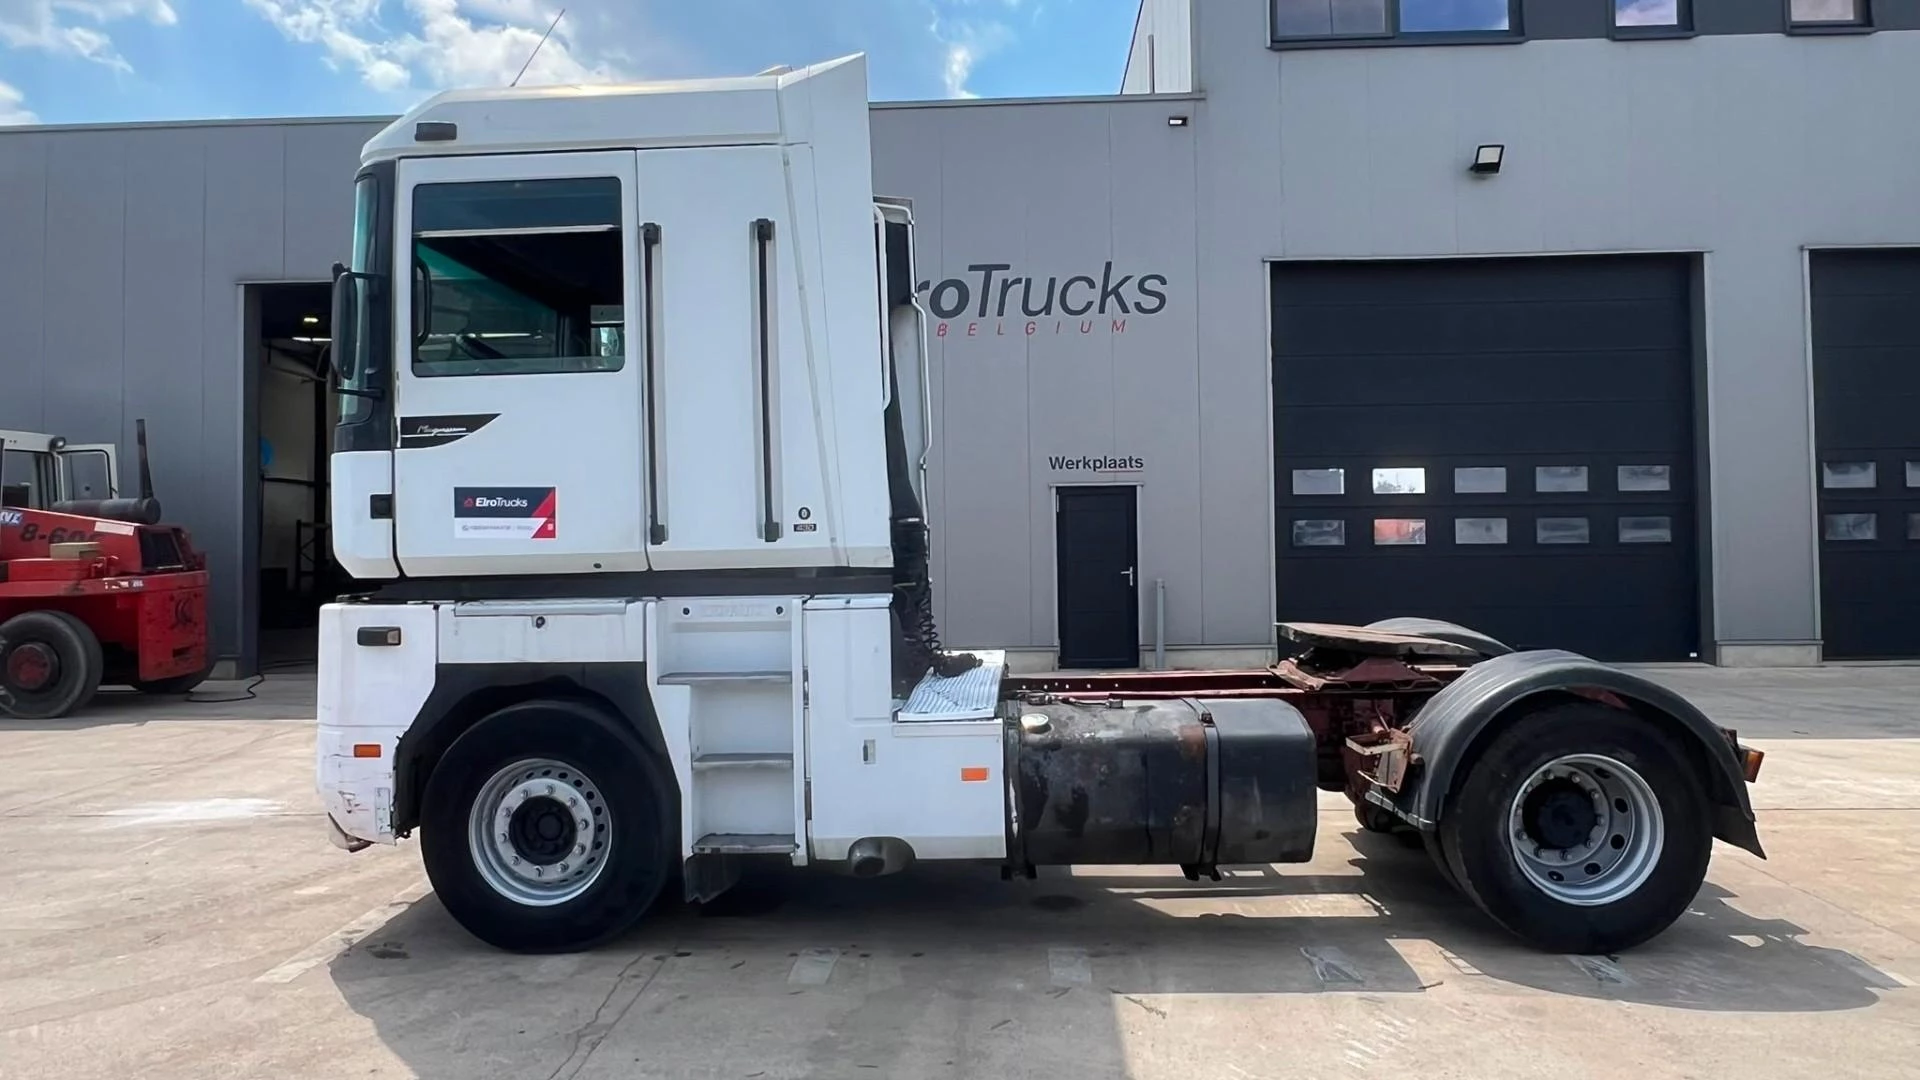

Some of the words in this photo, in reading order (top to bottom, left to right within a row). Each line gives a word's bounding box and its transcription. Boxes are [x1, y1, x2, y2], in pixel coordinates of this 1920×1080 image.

[937, 319, 1126, 337] BELGIUM
[1048, 456, 1144, 472] Werkplaats
[475, 497, 528, 507] ElroTrucks
